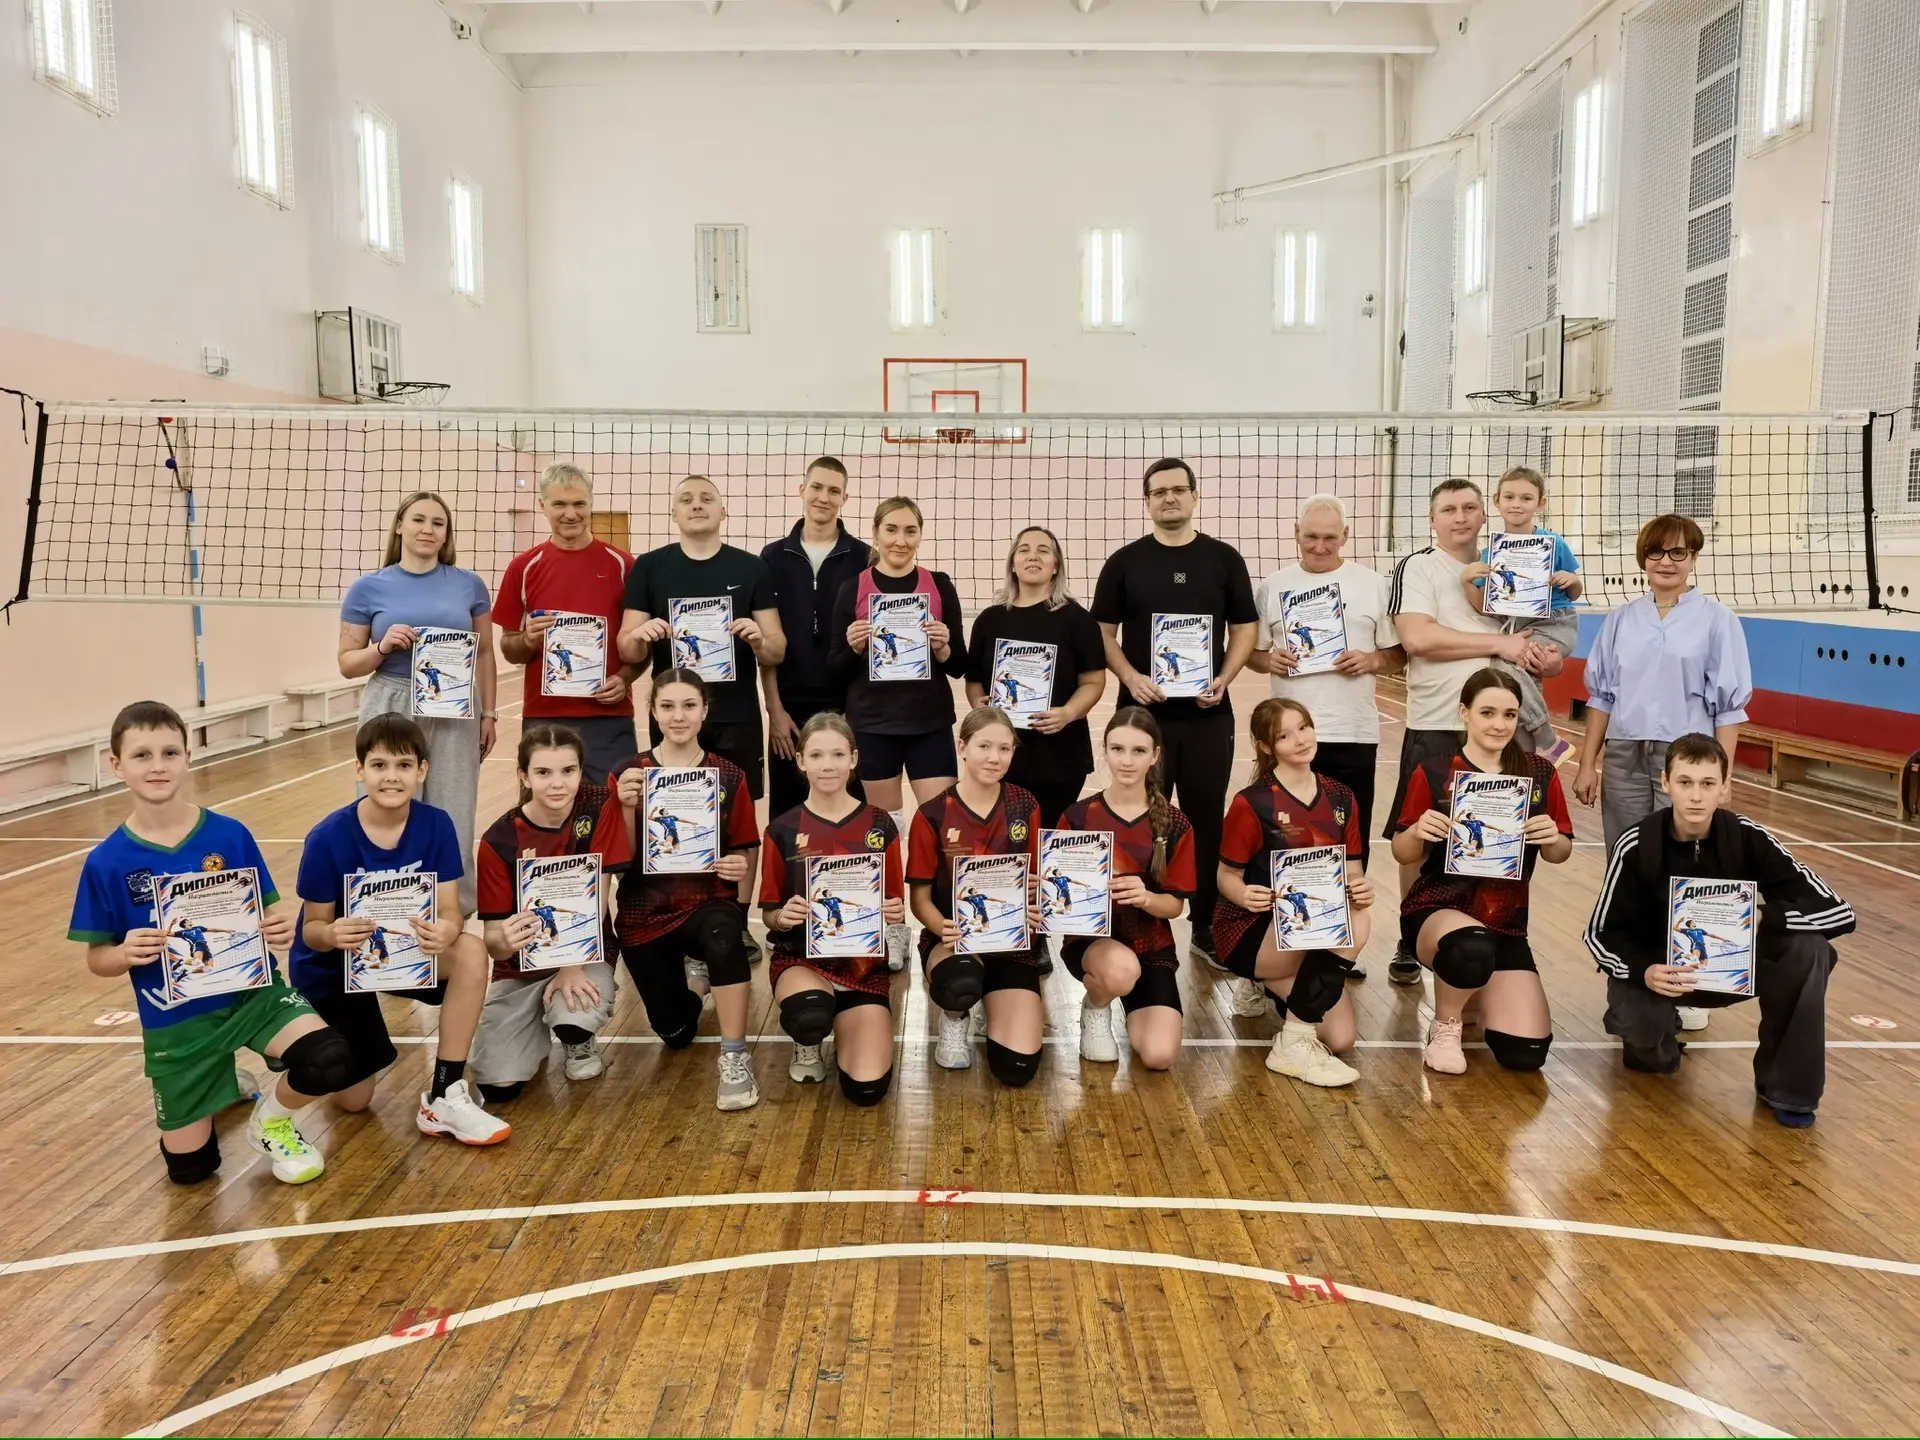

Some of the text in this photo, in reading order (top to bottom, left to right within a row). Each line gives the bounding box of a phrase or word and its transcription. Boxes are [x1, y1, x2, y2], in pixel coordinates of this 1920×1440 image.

[1499, 537, 1544, 550] ДИПЛОМ
[878, 595, 920, 612] ДИПЛОМ
[1289, 585, 1330, 608] ДИПЛОМ
[679, 599, 721, 615] ДИПЛОМ
[554, 616, 597, 628] ДИПЛОМ
[1161, 617, 1202, 631] ДИПЛОМ
[424, 633, 468, 645] ДИПЛОМ
[1004, 646, 1046, 657] ДИПЛОМ
[655, 770, 706, 790] ДИПЛОМ
[1465, 779, 1519, 793] ДИПЛОМ
[1050, 833, 1101, 850] ДИПЛОМ
[818, 855, 871, 873] ДИПЛОМ
[965, 855, 1018, 873] ДИПЛОМ
[1282, 847, 1333, 868] ДИПЛОМ
[530, 856, 587, 880] ДИПЛОМ
[170, 871, 239, 899] ДИПЛОМ
[358, 875, 421, 899] ДИПЛОМ
[1682, 883, 1741, 900] ДИПЛОМ
